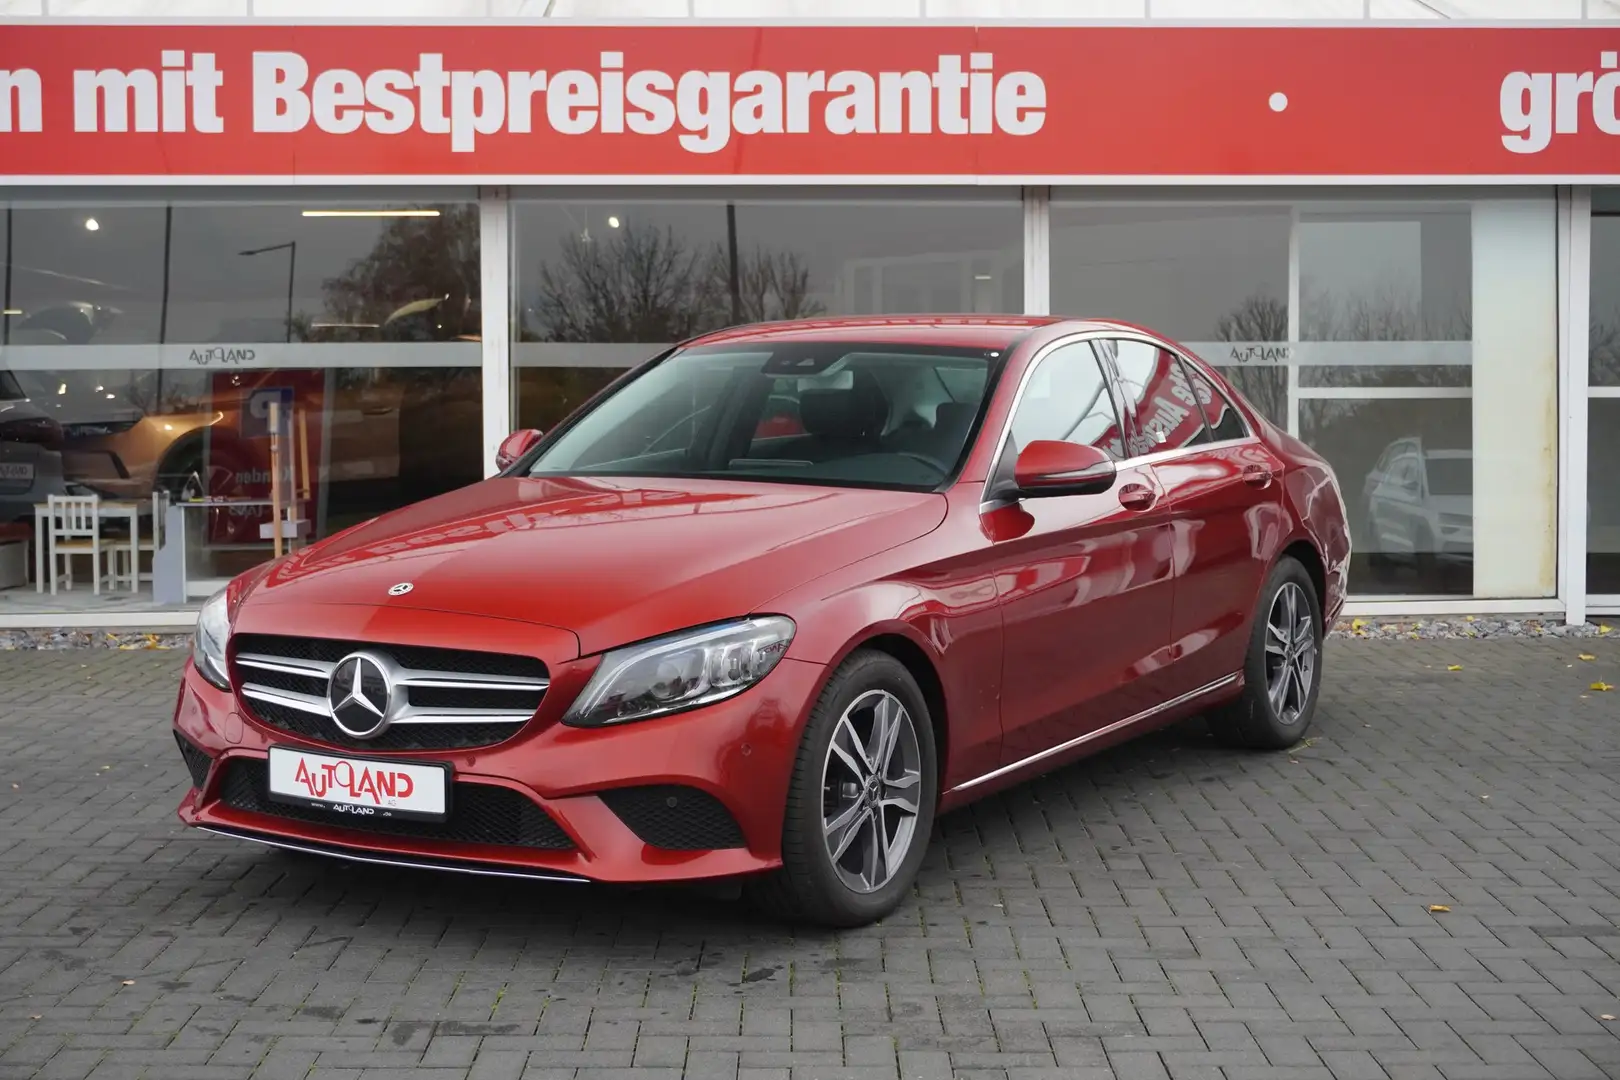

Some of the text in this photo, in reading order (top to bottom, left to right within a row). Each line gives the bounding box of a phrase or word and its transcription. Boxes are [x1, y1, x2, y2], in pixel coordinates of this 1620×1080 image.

[74, 50, 224, 133] mit
[253, 51, 1047, 153] Bestpreisgarantie
[295, 757, 414, 805] AUTOLAND
[333, 804, 375, 815] AUTOLAND
